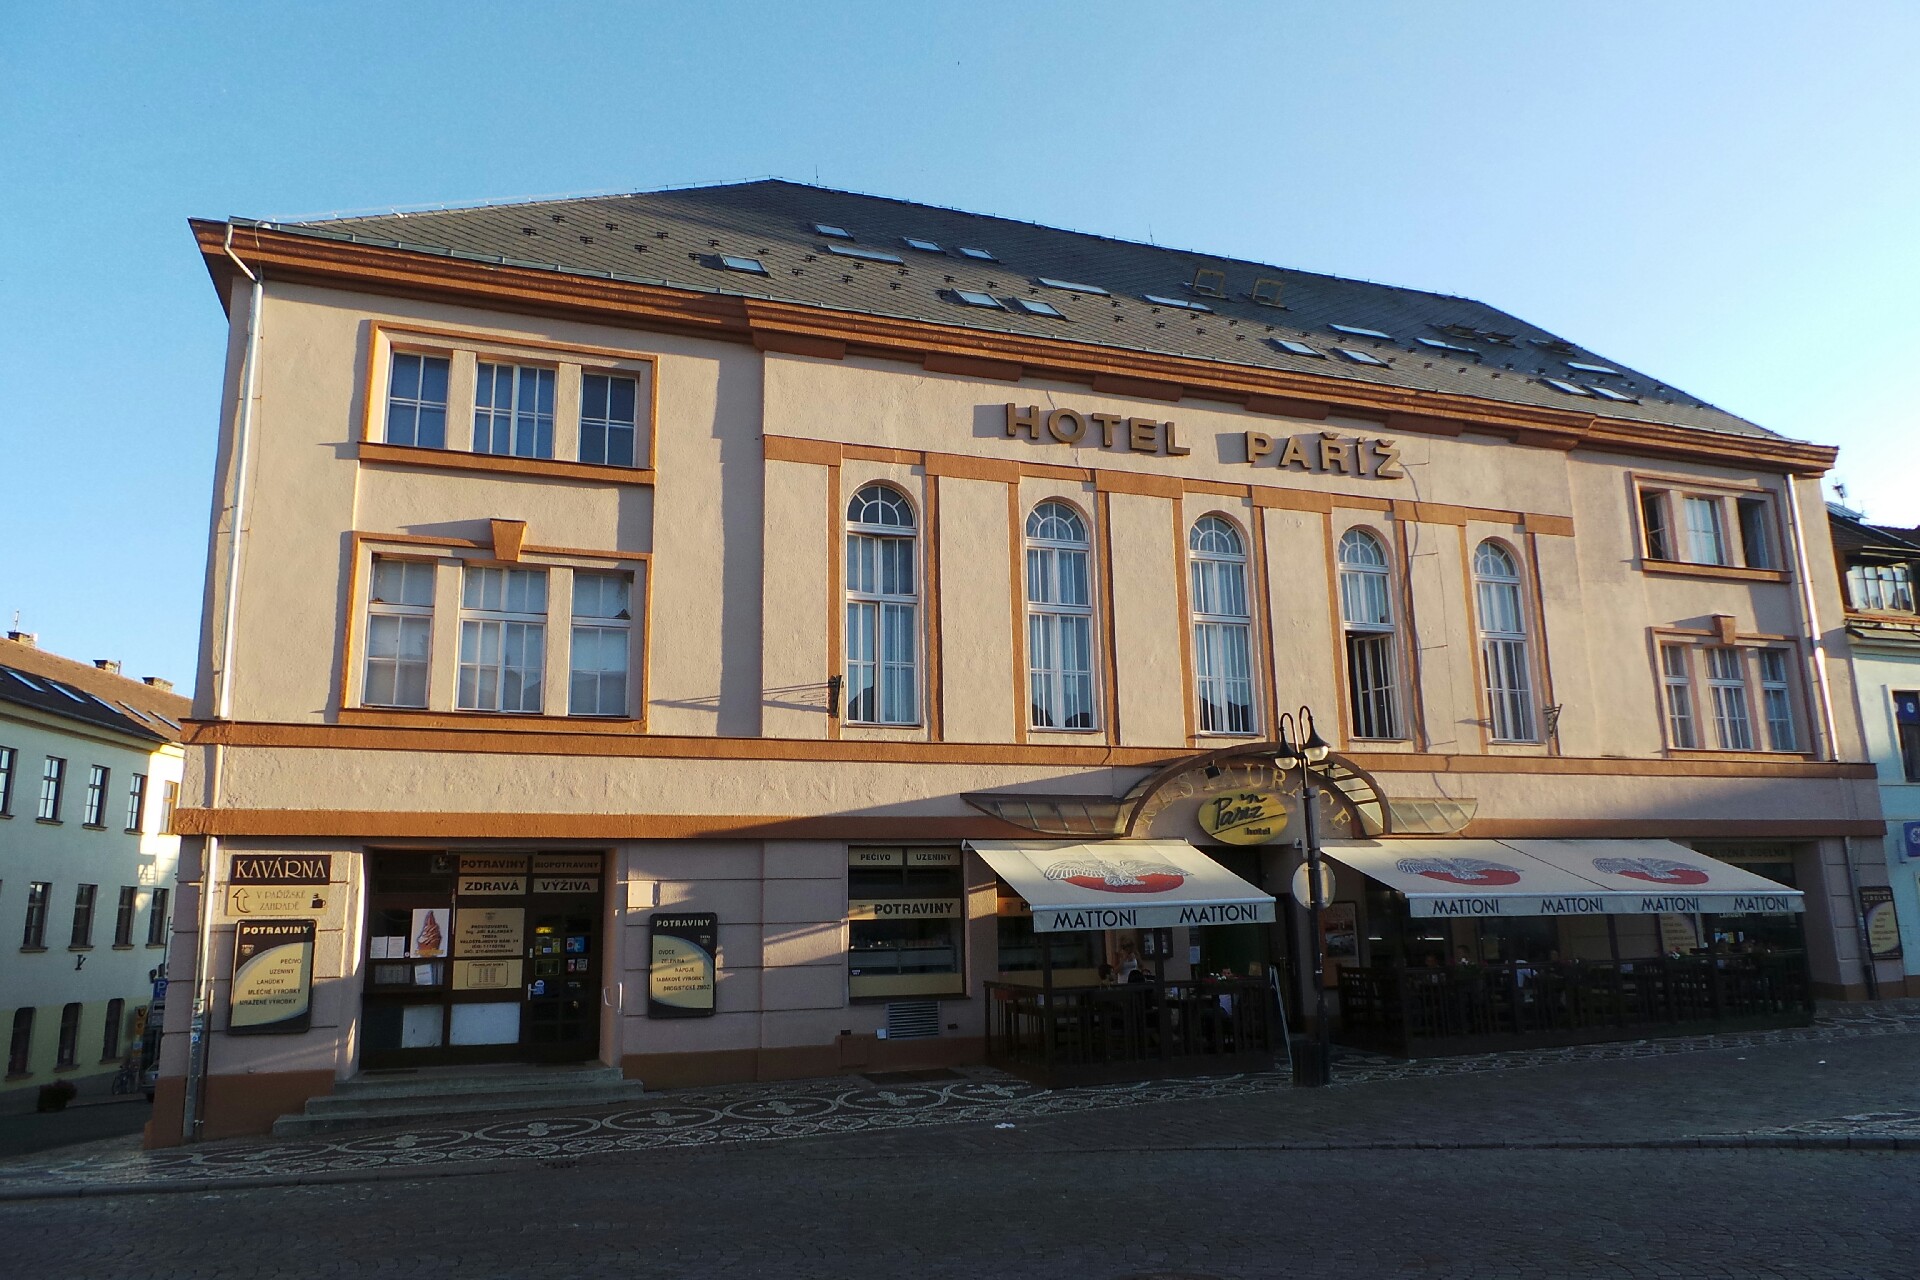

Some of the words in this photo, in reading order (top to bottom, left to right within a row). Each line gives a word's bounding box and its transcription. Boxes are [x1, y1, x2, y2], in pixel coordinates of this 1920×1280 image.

[1005, 402, 1190, 455] HOTEL
[1244, 431, 1404, 480] PAŘÍŽ
[1244, 827, 1271, 836] hotel
[860, 853, 891, 861] PEČIVO
[916, 853, 952, 861] UZENINY
[235, 857, 326, 879] KAVÁRNA
[461, 860, 525, 869] POTRAVINY
[465, 879, 519, 891] ZDRAVÁ
[542, 879, 591, 891] VÝŽIVA
[256, 891, 261, 899] V
[259, 901, 299, 911] ZAHRADĚ
[874, 903, 954, 915] POTRAVINY
[1433, 898, 1499, 915] MATTONI
[1541, 897, 1603, 913] MATTONI
[1641, 897, 1699, 912] MATTONI
[1733, 896, 1789, 911] MATTONI
[1053, 909, 1137, 929] MATTONI
[1179, 904, 1257, 924] MATTONI
[656, 919, 711, 927] POTRAVINY
[243, 926, 310, 935] POTRAVINY
[158, 982, 166, 992] P
